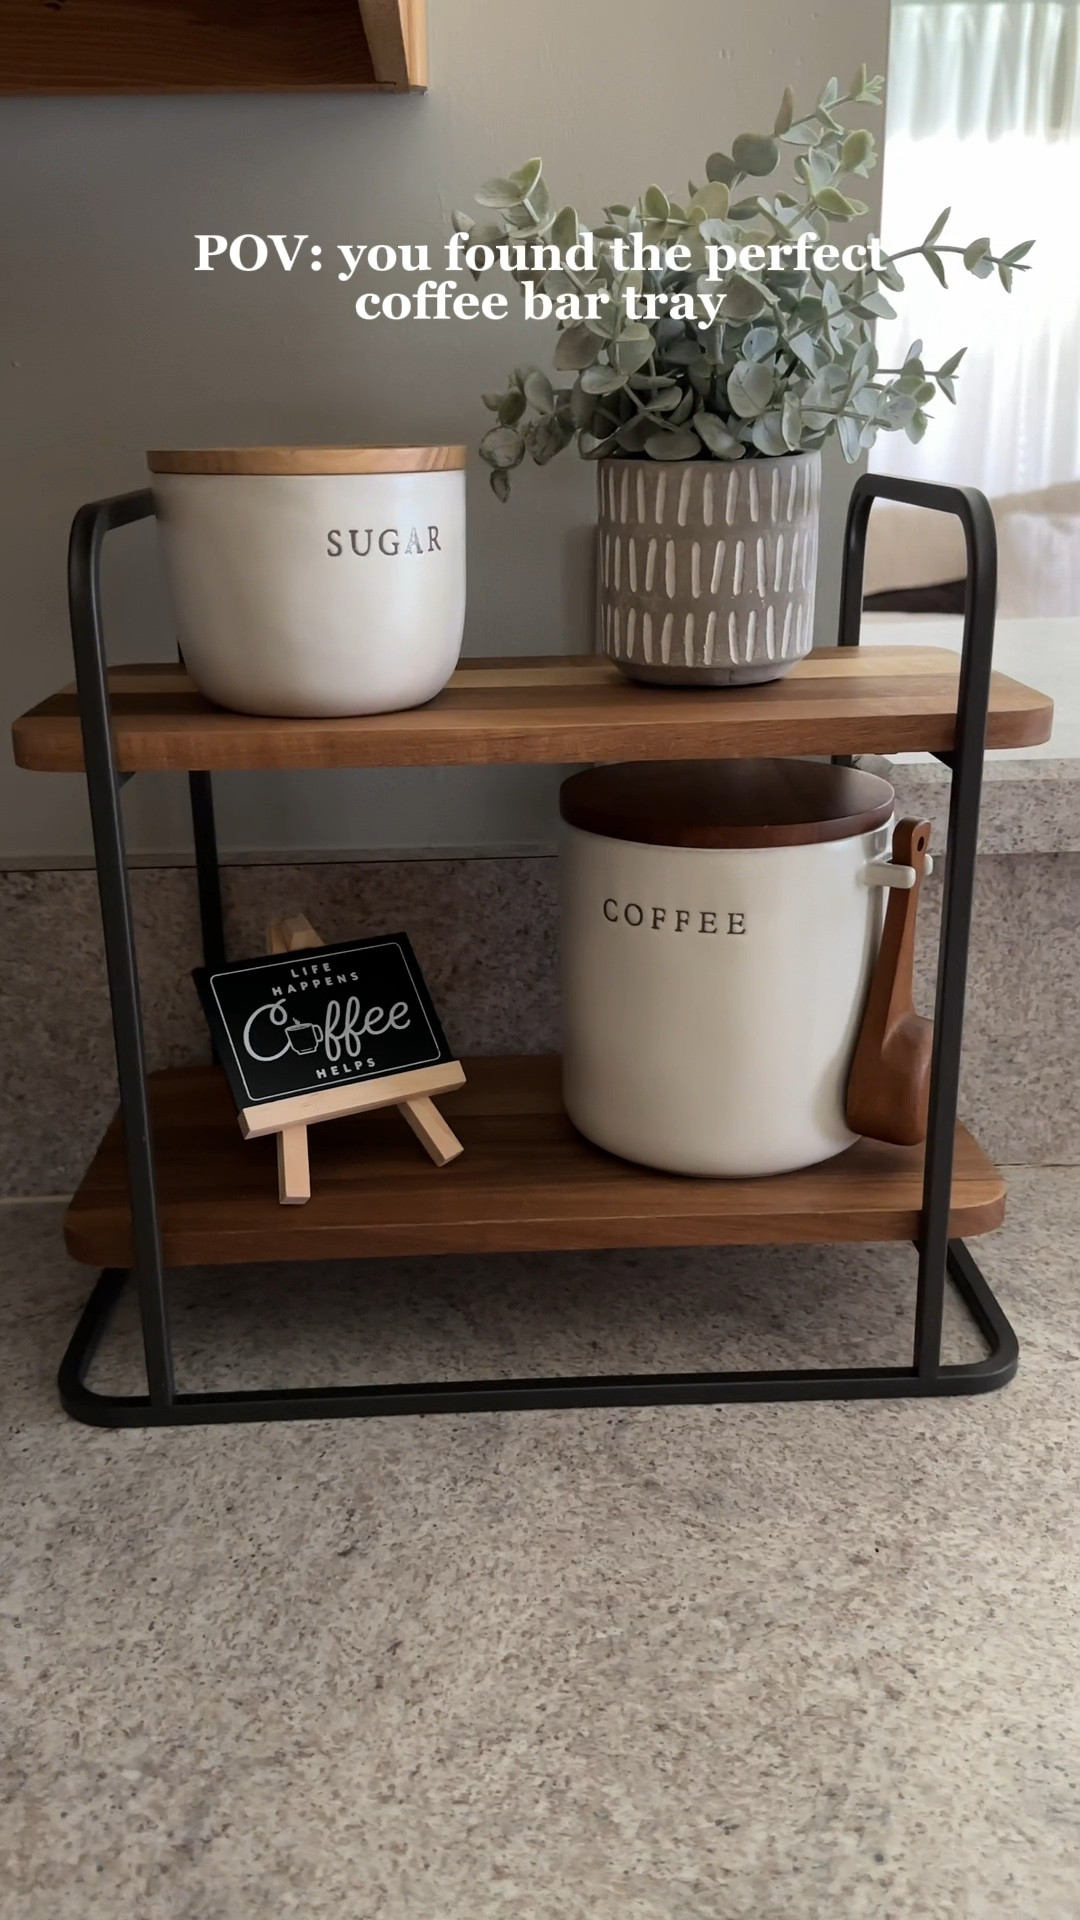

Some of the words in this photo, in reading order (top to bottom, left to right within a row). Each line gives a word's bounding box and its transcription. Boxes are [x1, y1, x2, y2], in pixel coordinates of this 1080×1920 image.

[327, 526, 441, 557] SUGAR
[603, 898, 746, 935] COFFEE
[290, 962, 331, 978] LIFE
[272, 972, 359, 996] HAPPENS
[316, 1057, 376, 1079] HELPS
